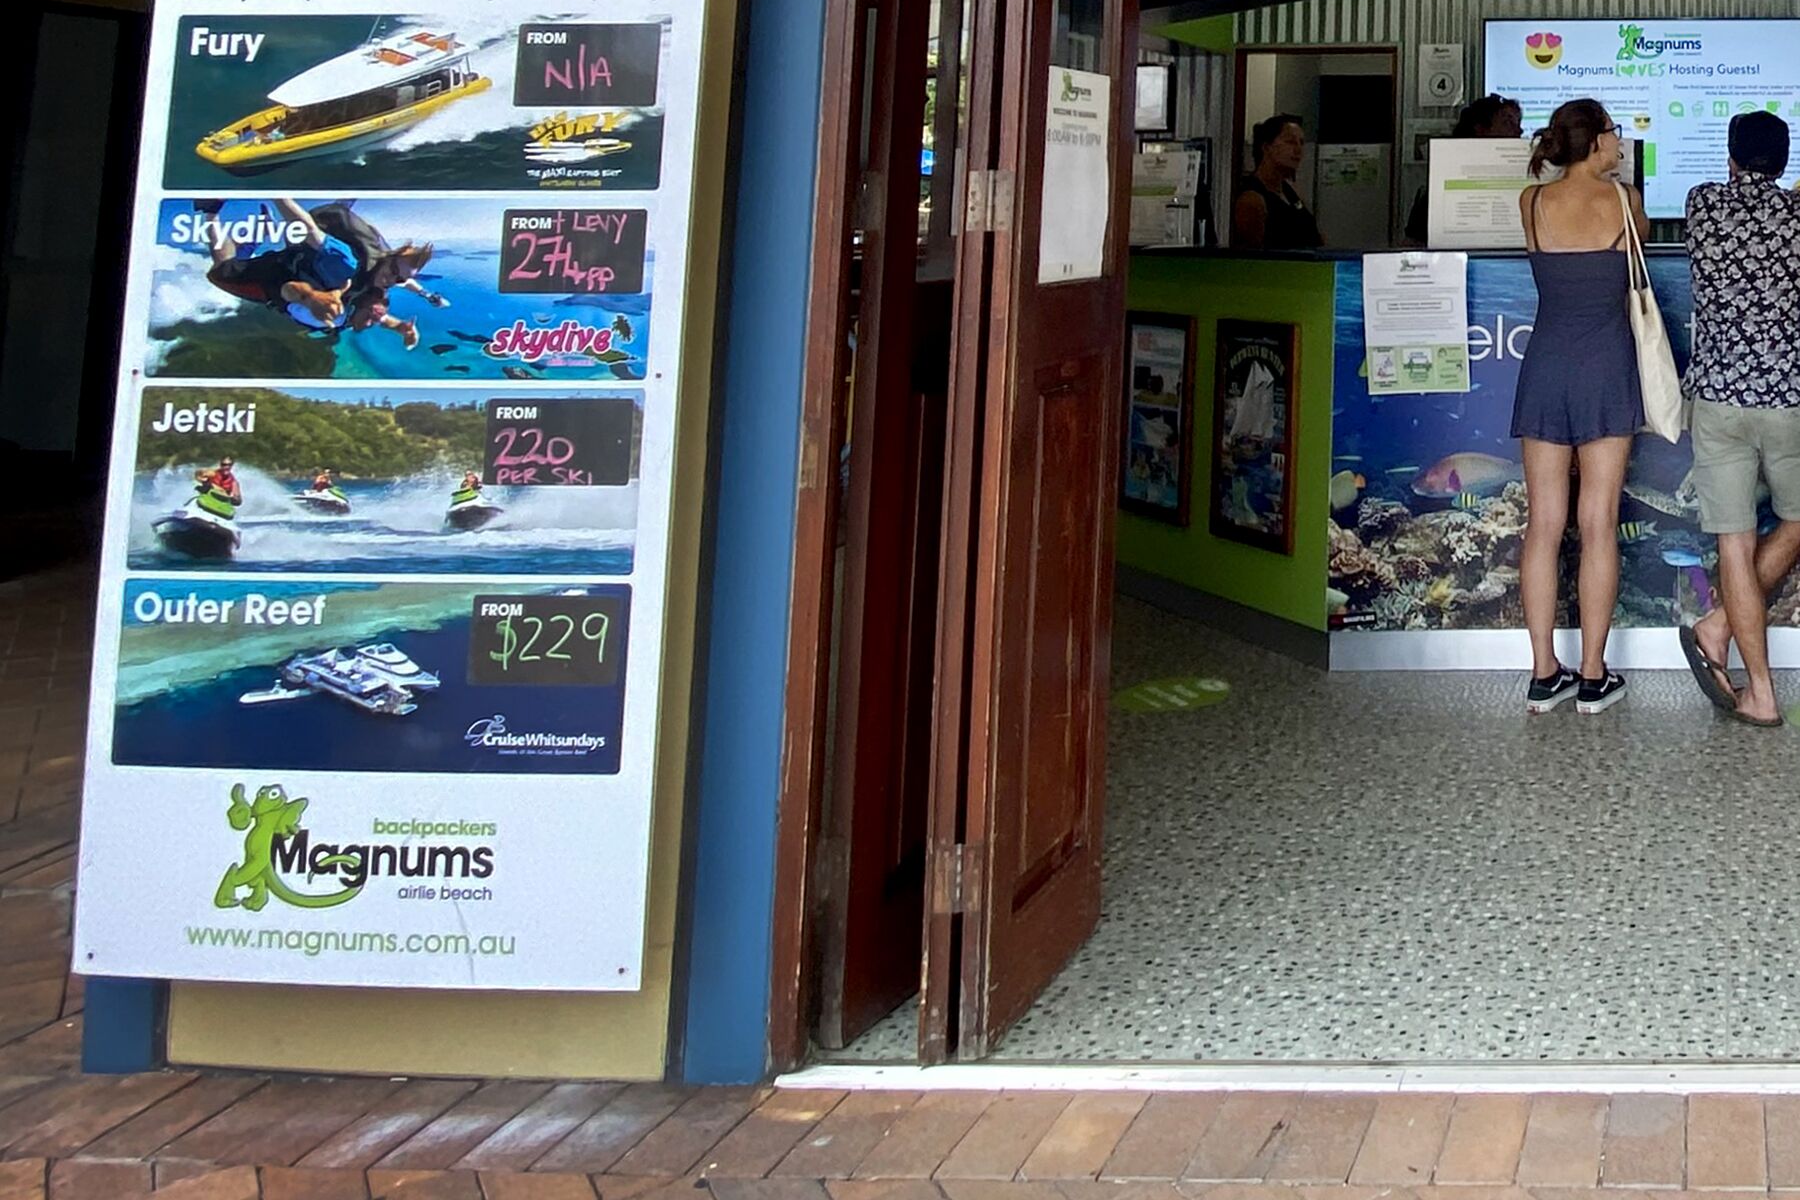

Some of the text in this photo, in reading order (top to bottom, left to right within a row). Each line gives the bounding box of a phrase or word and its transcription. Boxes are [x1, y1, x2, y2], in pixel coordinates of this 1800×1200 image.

[190, 28, 265, 62] Fury
[526, 31, 567, 44] FROM
[1633, 37, 1702, 53] Magnums
[544, 43, 613, 92] N/A
[1558, 64, 1614, 78] Magnums
[1669, 63, 1714, 77] Hosting
[1716, 63, 1761, 75] Guests!
[1437, 78, 1447, 91] 4
[171, 214, 308, 250] Skydive
[511, 217, 552, 229] FROM
[572, 211, 628, 244] LEVY
[492, 321, 613, 361] skydive
[152, 403, 256, 434] Jetski
[496, 406, 537, 419] FROM
[494, 427, 575, 466] 220
[496, 467, 593, 485] PER SKI
[133, 593, 326, 626] Outer Reef
[481, 603, 523, 617] FROM
[489, 612, 609, 671] $229
[373, 818, 497, 840] backpackers
[271, 830, 495, 888] Magnums
[398, 885, 493, 901] airlie beach
[184, 927, 516, 958] www.magnums.com.au
